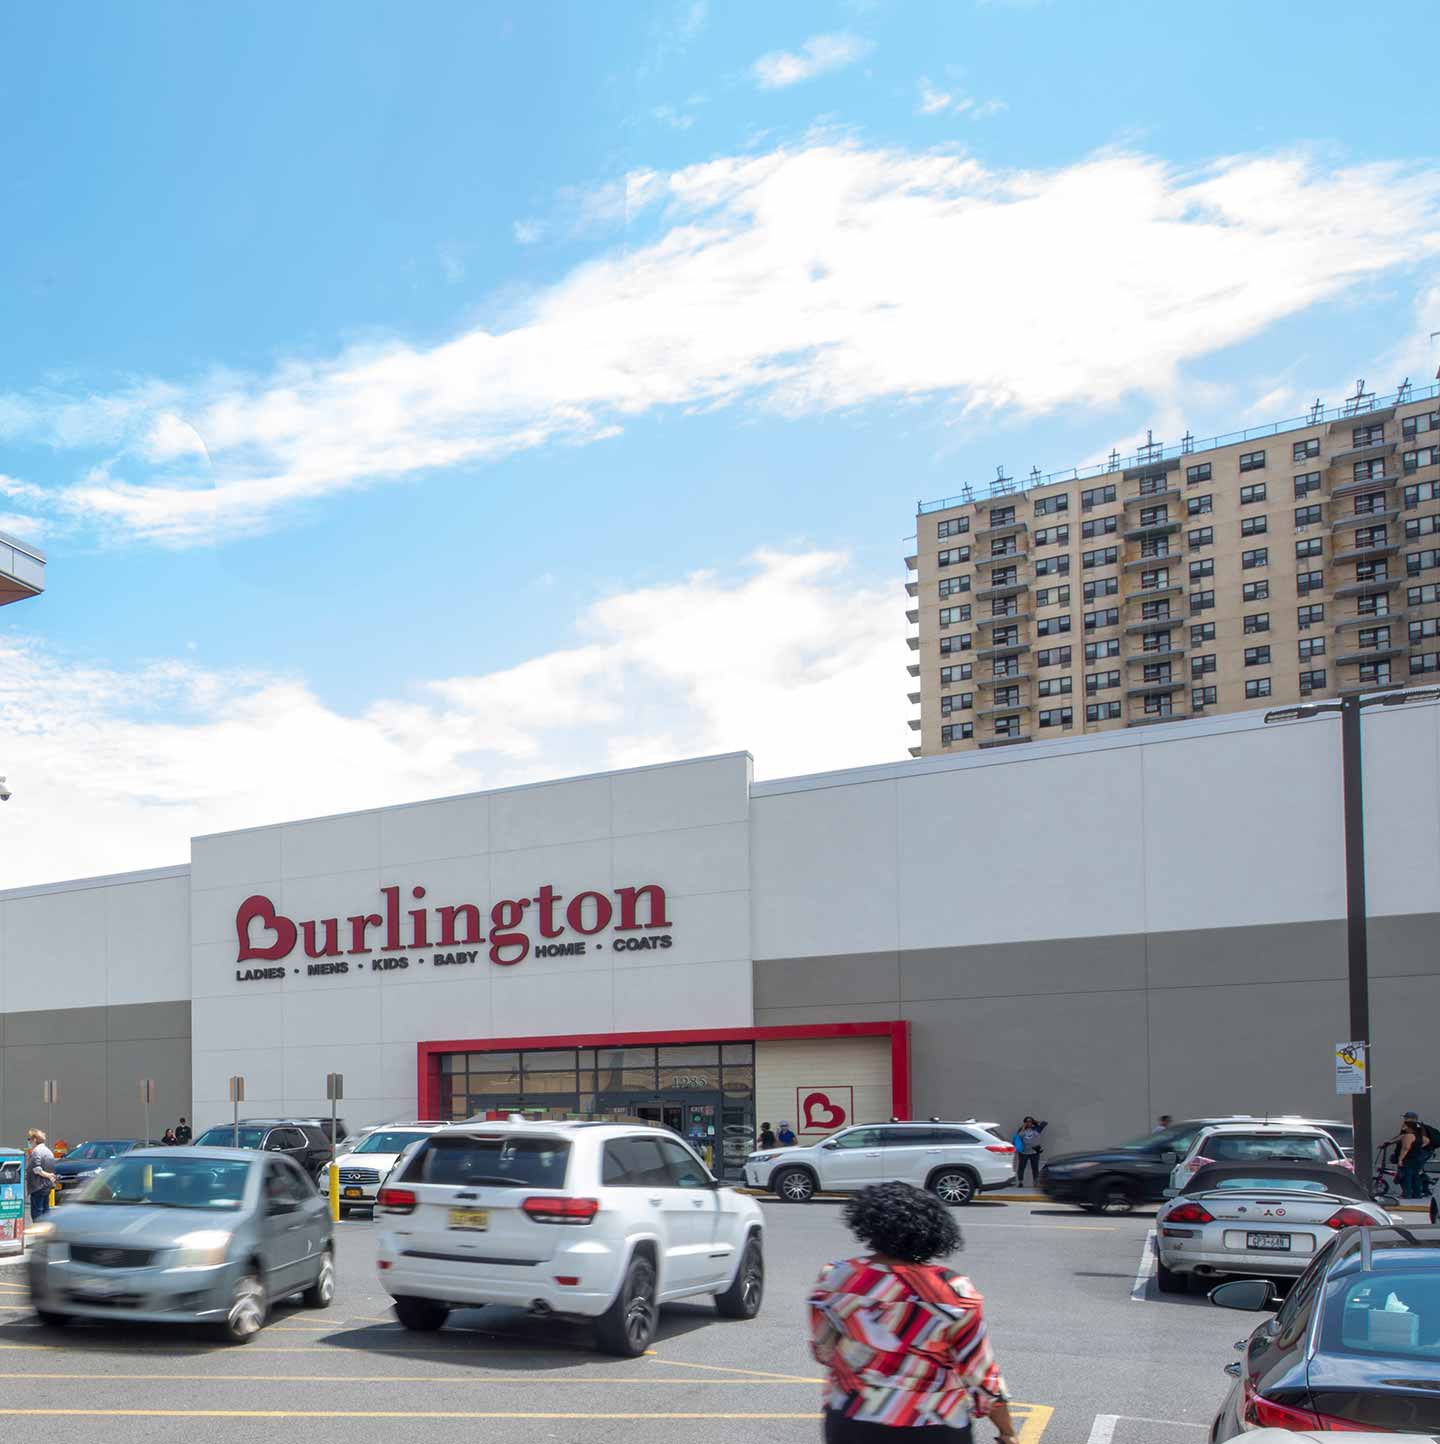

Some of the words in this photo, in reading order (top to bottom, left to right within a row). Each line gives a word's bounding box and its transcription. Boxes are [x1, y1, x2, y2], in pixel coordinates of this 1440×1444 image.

[236, 884, 673, 966] Burlington
[236, 967, 286, 982] LADIES
[307, 961, 349, 976] MENS
[371, 957, 409, 971] KIDS
[433, 951, 479, 966] BABY
[535, 941, 586, 958] HOME
[613, 934, 673, 952] COATS
